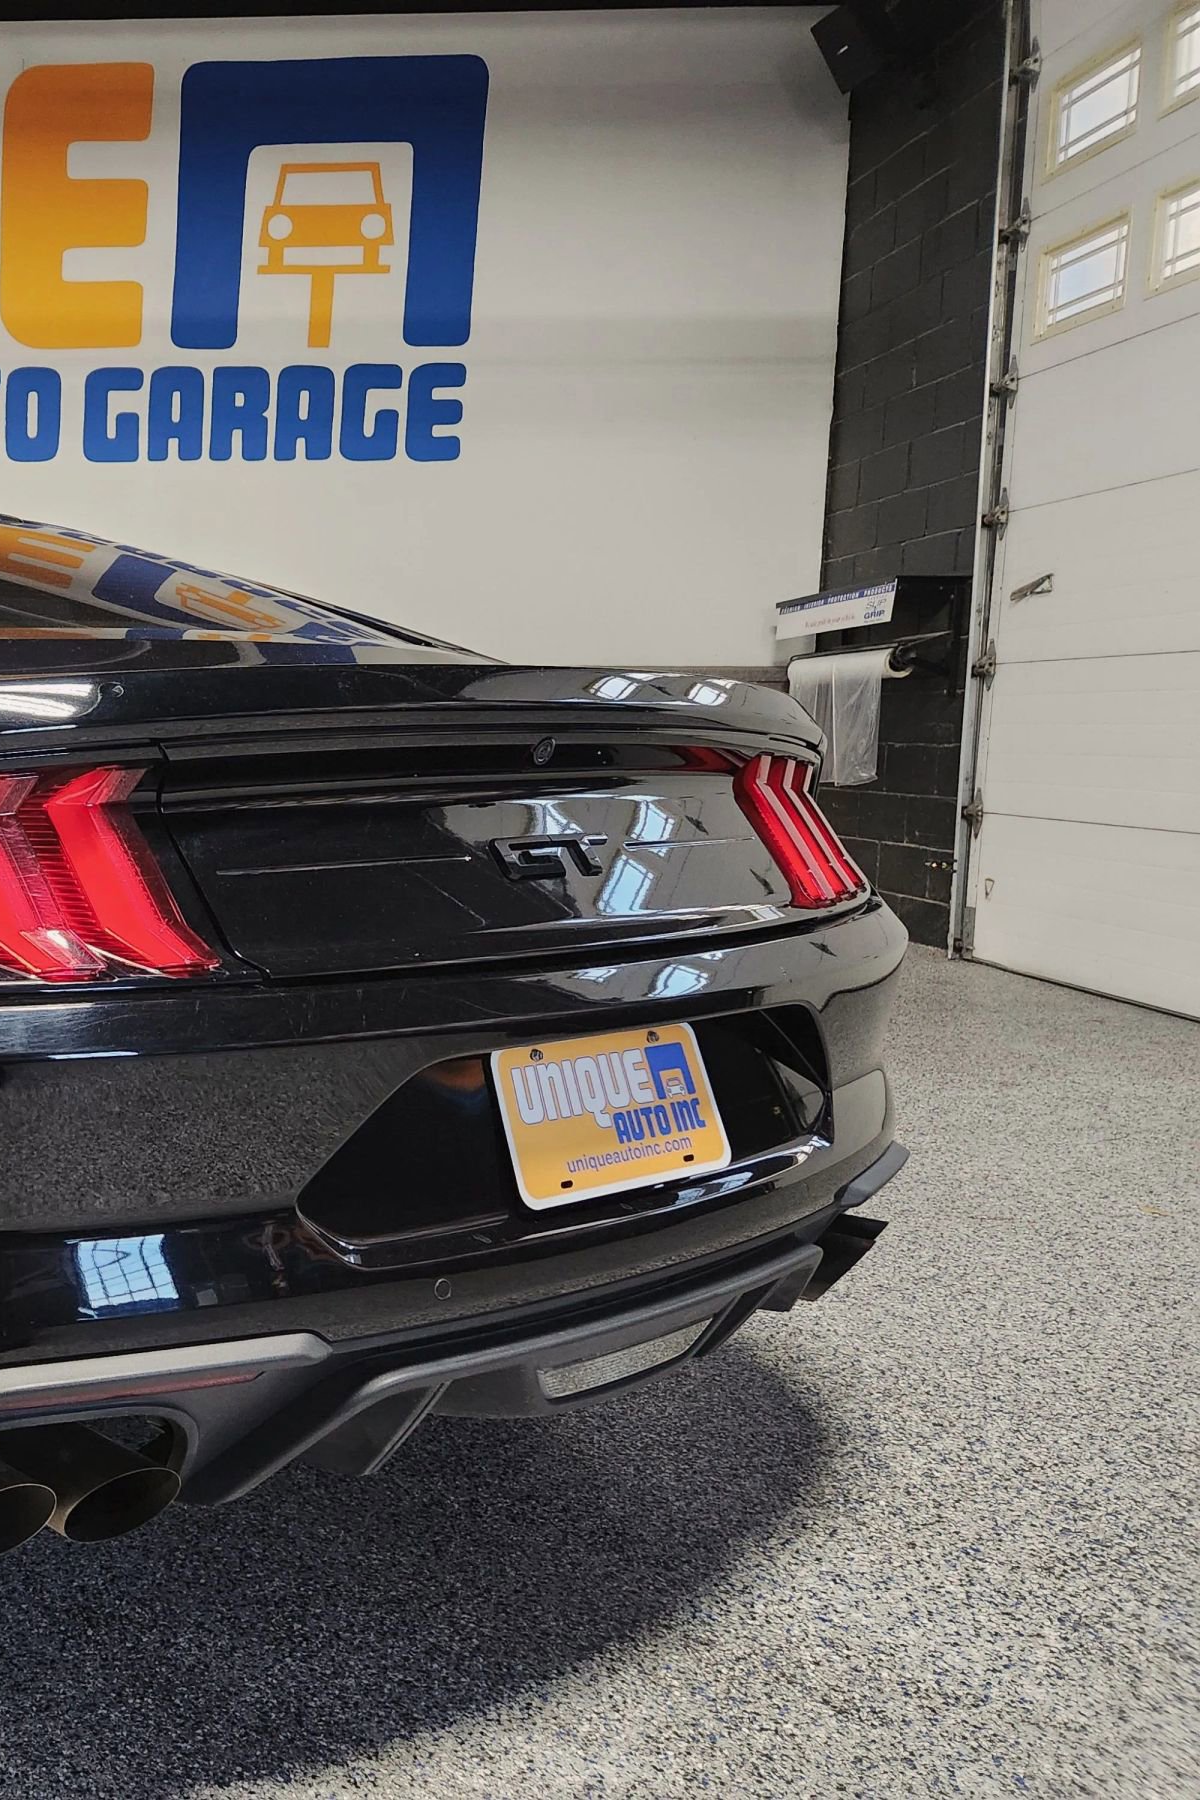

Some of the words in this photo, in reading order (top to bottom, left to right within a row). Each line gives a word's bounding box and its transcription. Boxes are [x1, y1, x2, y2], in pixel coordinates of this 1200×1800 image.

[82, 362, 467, 462] GARAGE
[827, 592, 860, 604] PROTECTION
[863, 583, 893, 596] PRODUCTS
[863, 609, 886, 620] GRIP
[488, 833, 608, 882] GT
[510, 1048, 655, 1128] UNIQUE
[612, 1105, 672, 1144] AUTO
[670, 1098, 706, 1133] INC
[566, 1136, 693, 1174] uniqueautoinc.com
